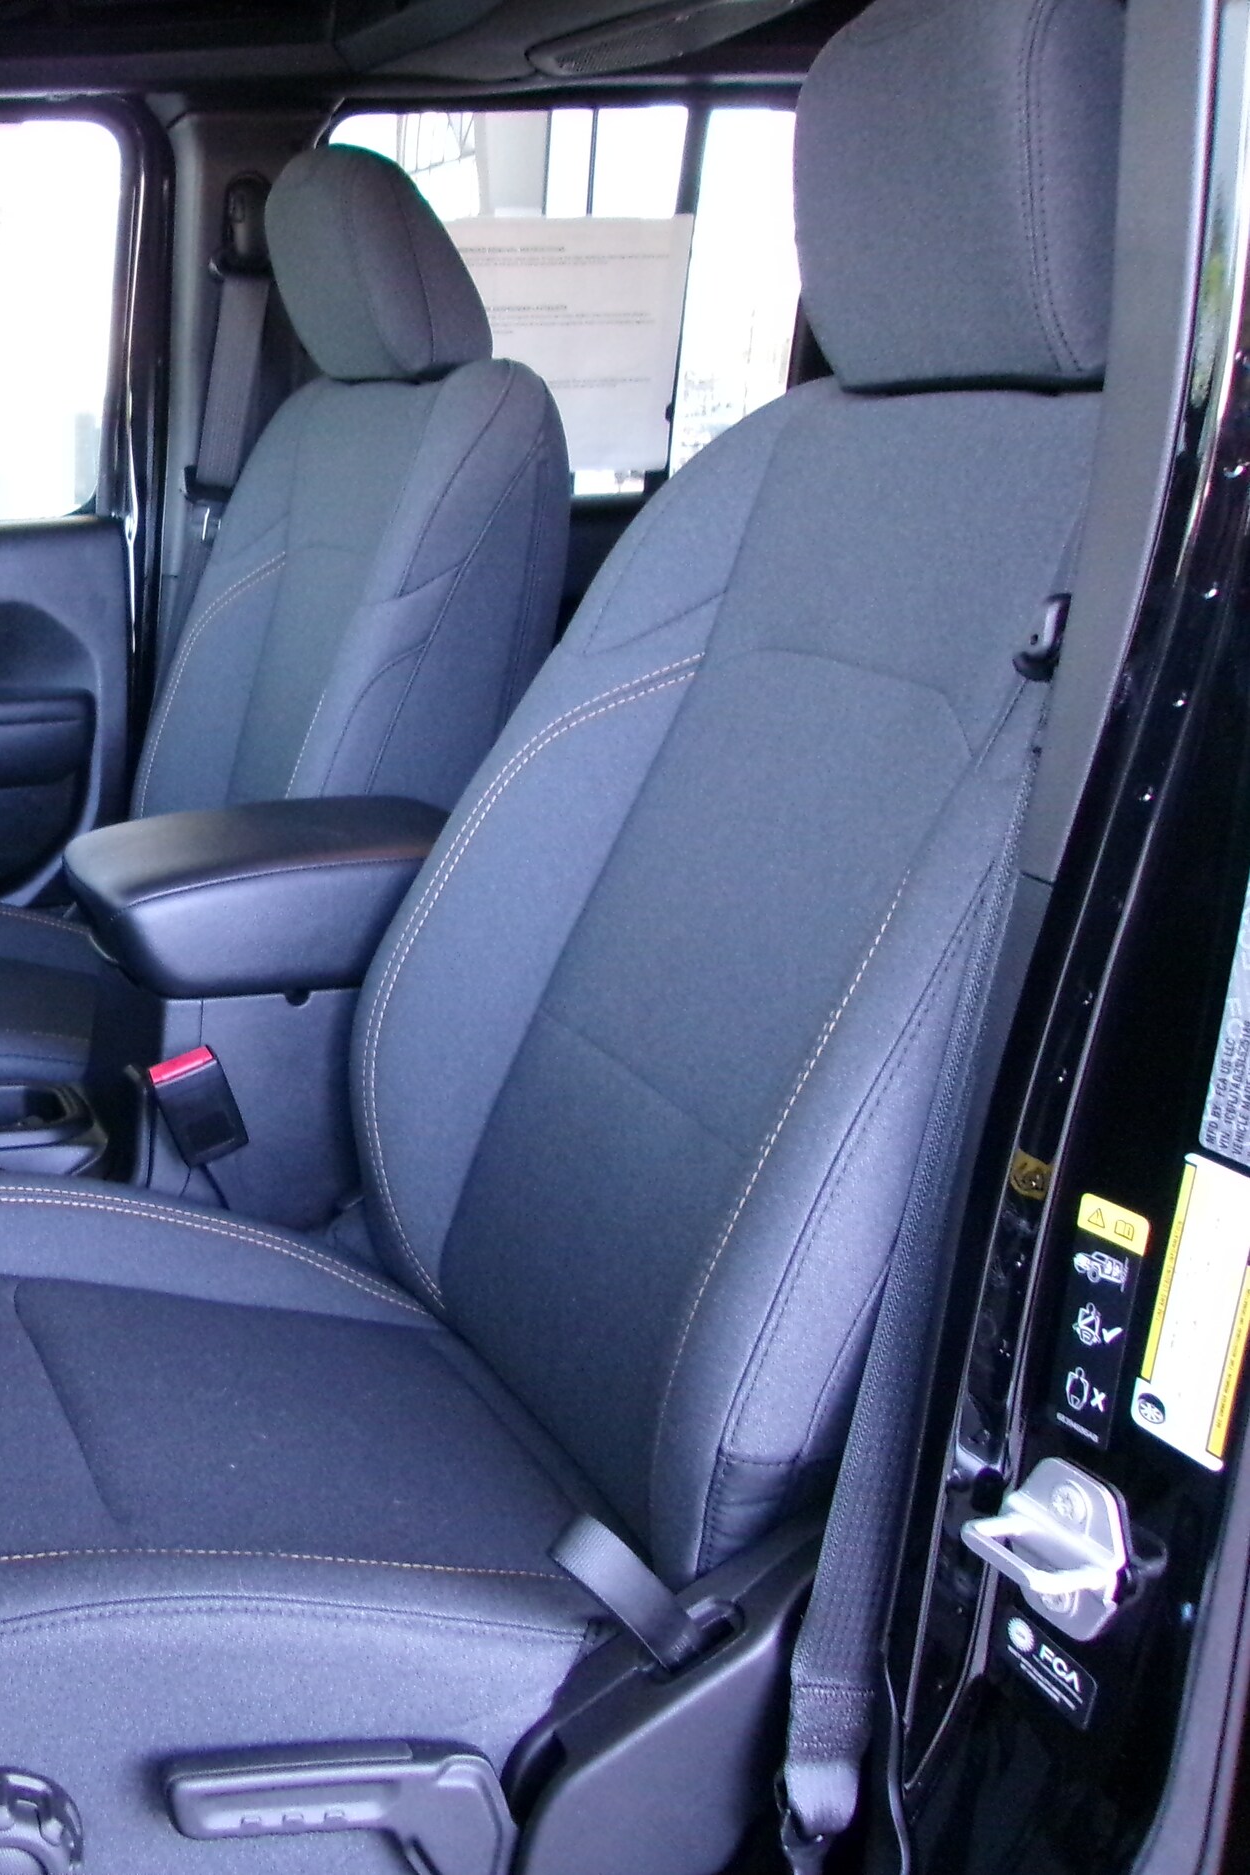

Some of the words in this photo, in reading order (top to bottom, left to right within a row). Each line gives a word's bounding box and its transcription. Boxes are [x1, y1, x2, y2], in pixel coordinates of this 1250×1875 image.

[1224, 1038, 1235, 1057] LLC
[1220, 1058, 1231, 1075] US
[1215, 1078, 1228, 1098] FCA
[1232, 1114, 1249, 1156] VEHICLE
[1039, 1644, 1081, 1692] FCA
